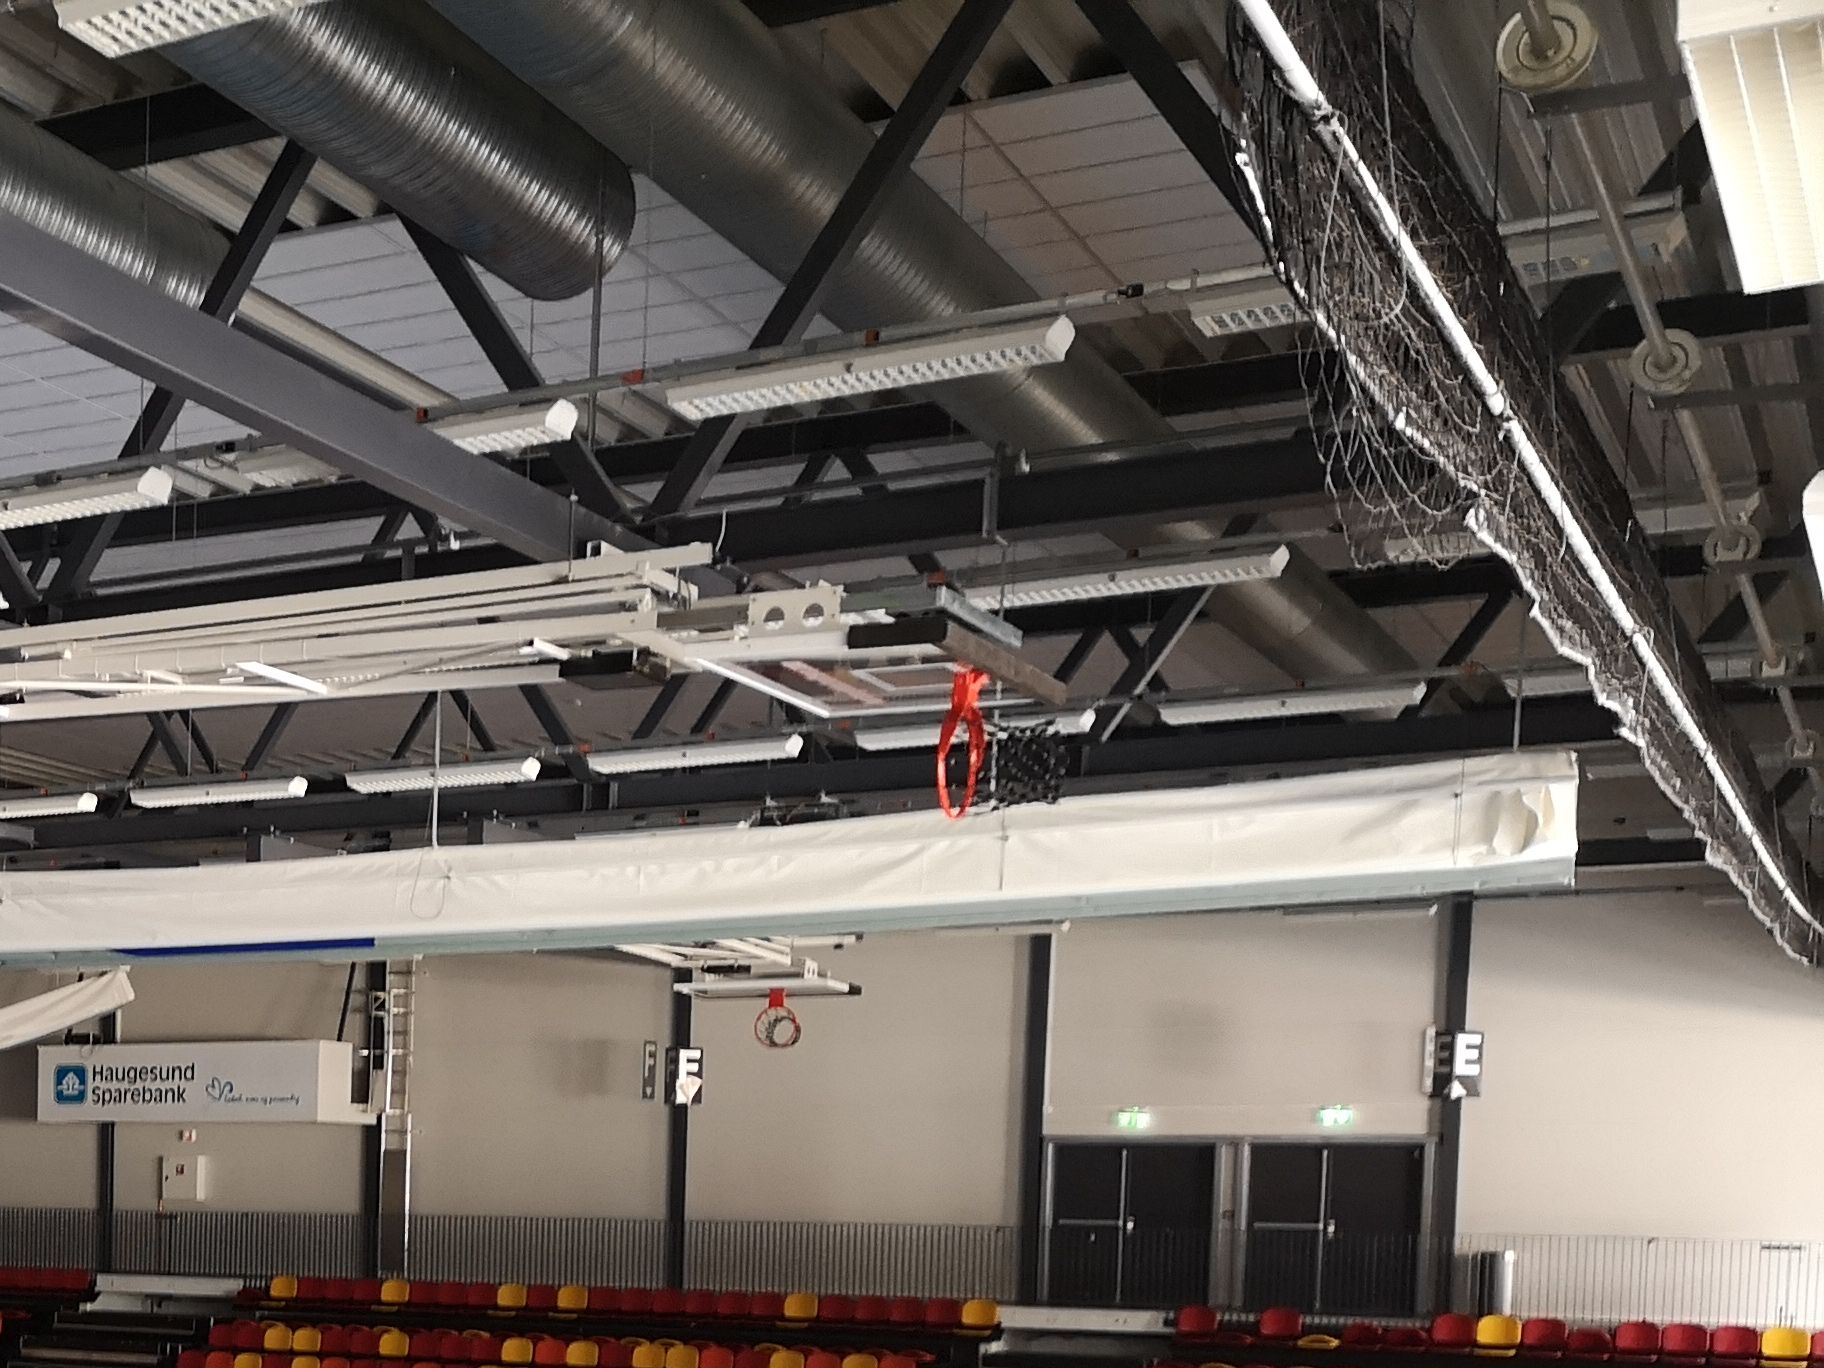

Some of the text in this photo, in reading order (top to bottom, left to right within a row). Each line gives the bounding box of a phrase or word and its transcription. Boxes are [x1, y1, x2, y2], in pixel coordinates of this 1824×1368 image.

[644, 1043, 656, 1077] F
[678, 1048, 702, 1085] F
[1455, 1033, 1482, 1076] E
[91, 1062, 195, 1085] Haugesund
[91, 1085, 187, 1108] Sparebank
